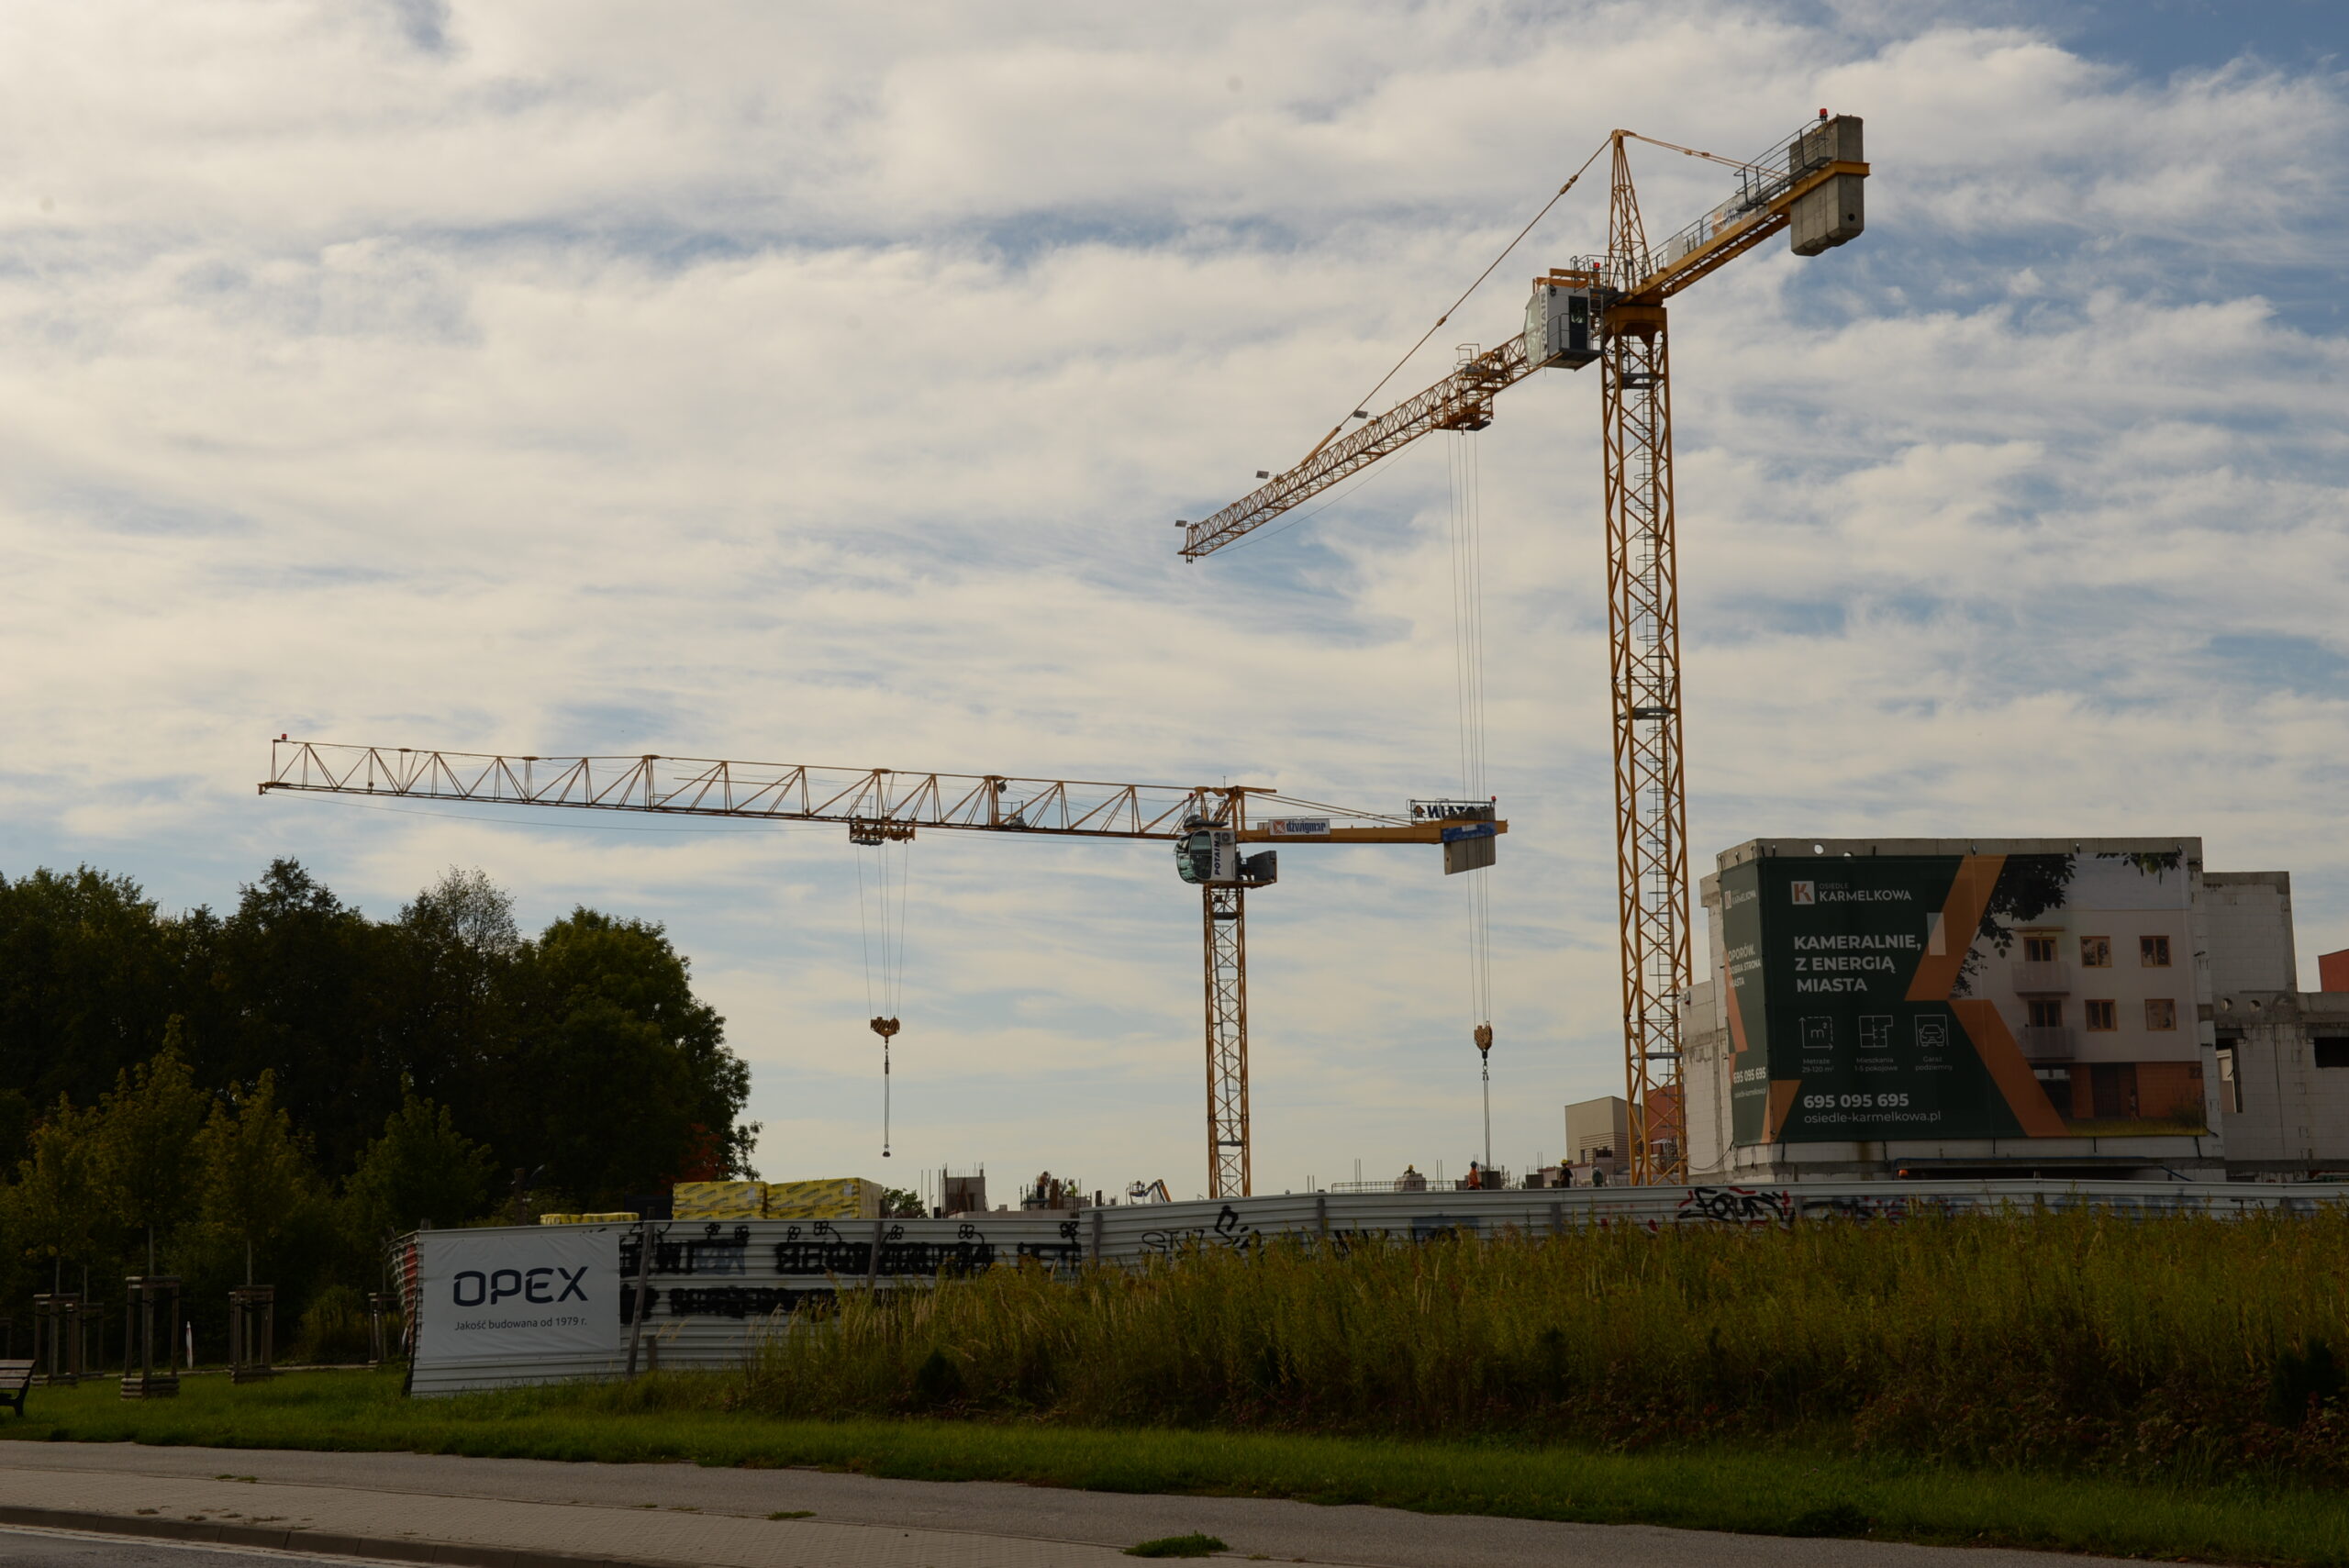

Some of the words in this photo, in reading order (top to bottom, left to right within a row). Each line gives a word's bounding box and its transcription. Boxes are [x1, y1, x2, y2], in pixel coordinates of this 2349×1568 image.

[1820, 890, 1912, 902] KARMELKOWA
[1794, 935, 1921, 951] KAMERALNIE,
[1795, 958, 1808, 971] Z
[1812, 956, 1896, 973] ENERGIĄ
[1797, 978, 1867, 992] MIASTA
[1865, 1064, 1898, 1073] pokojowe
[1915, 1063, 1953, 1072] podziemny
[1803, 1095, 1835, 1108] 695
[1840, 1095, 1873, 1107] 095
[1877, 1094, 1909, 1106] 695
[1804, 1111, 1942, 1123] osiedle-karmelkowa.pl
[453, 1266, 589, 1307] OPEX
[454, 1319, 486, 1330] Jakość
[488, 1318, 538, 1329] budowana
[540, 1318, 552, 1327] od
[556, 1317, 579, 1327] 1979
